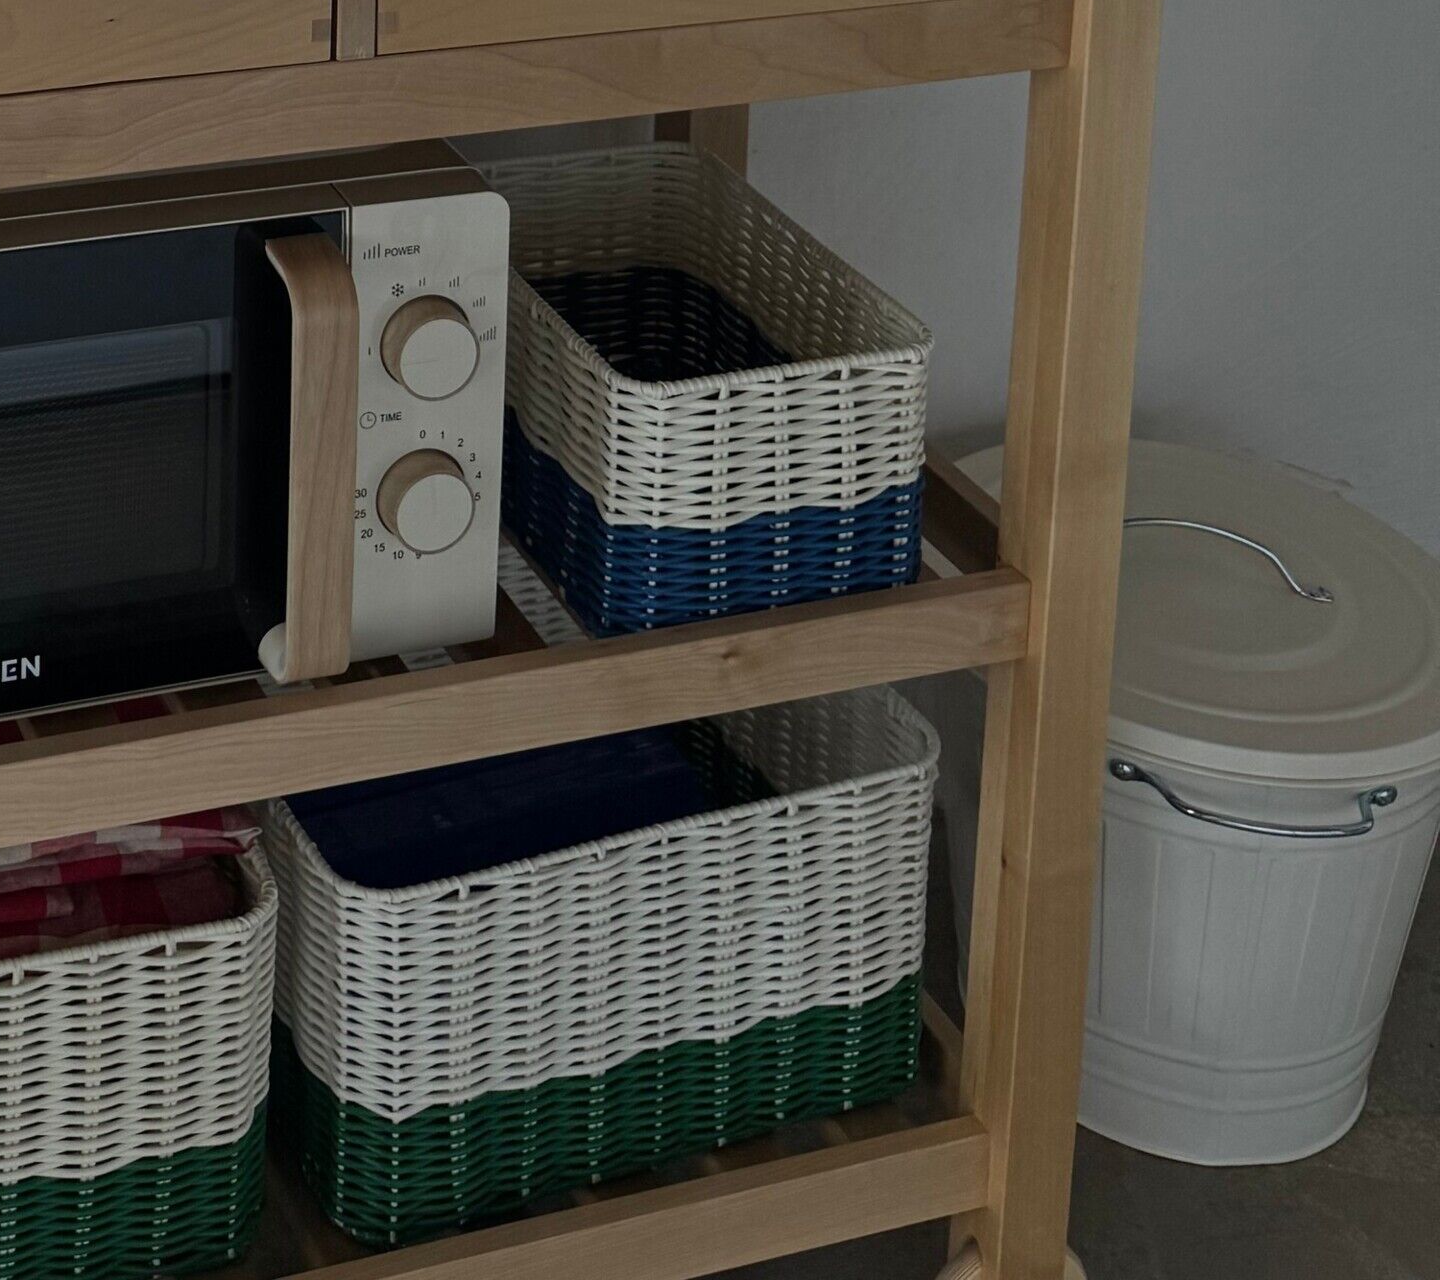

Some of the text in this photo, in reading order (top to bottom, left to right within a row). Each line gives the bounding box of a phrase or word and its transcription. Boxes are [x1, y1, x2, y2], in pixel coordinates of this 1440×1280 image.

[384, 244, 420, 258] POWER
[380, 411, 402, 423] TIME
[419, 429, 426, 439] 0
[440, 430, 445, 439] 1
[457, 438, 464, 448] 2
[469, 452, 476, 462] 3
[475, 471, 482, 479] 4
[354, 488, 367, 498] 30
[354, 509, 367, 519] 25
[361, 528, 373, 539] 20
[374, 543, 386, 552] 15
[393, 550, 404, 559] 10
